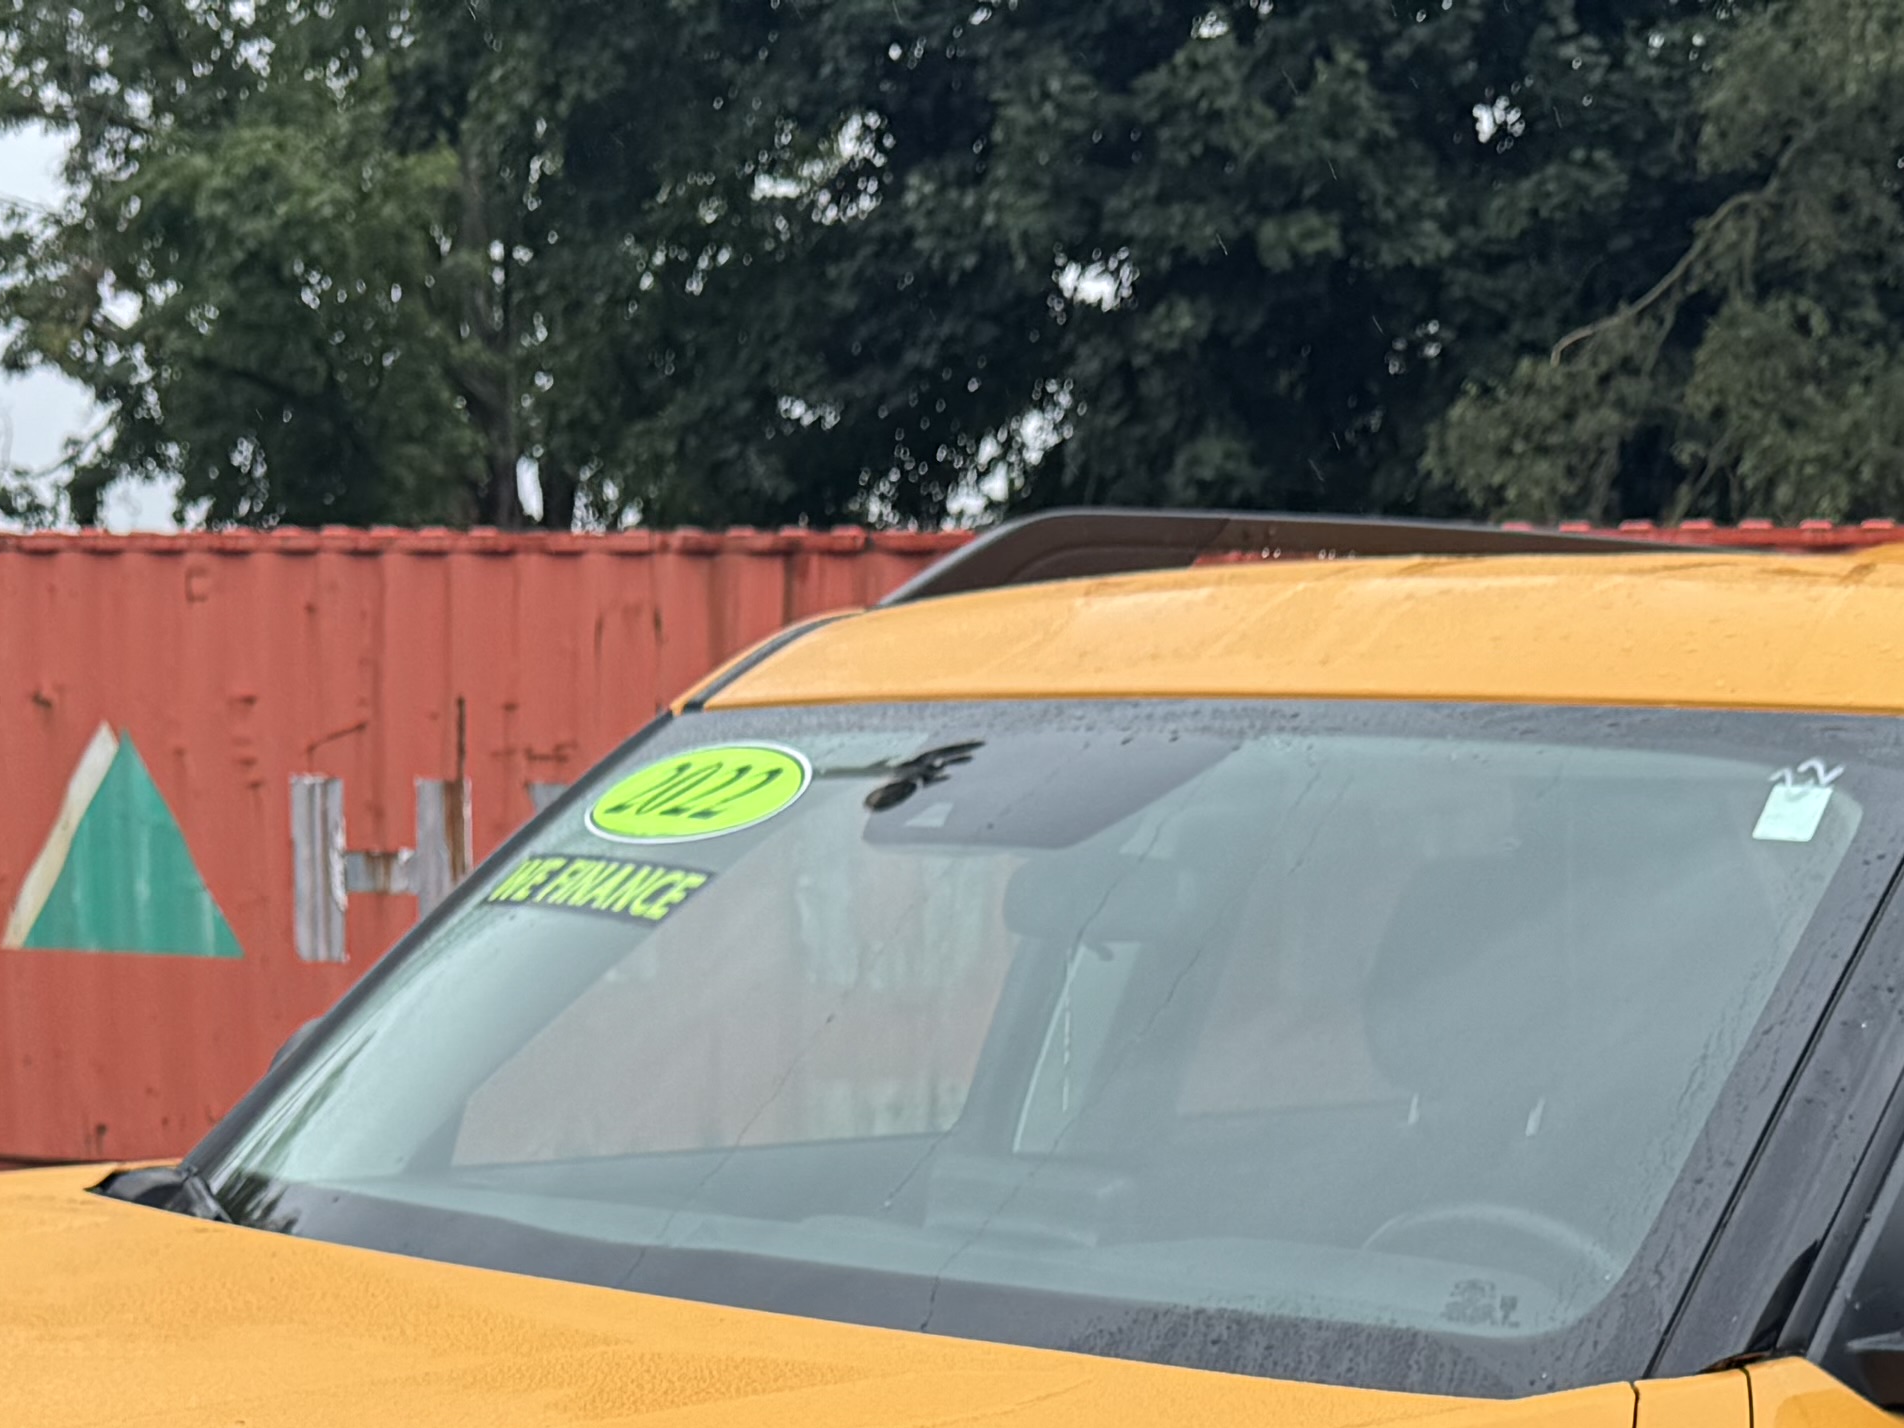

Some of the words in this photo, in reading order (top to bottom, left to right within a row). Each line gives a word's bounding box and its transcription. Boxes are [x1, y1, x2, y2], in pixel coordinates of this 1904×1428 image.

[603, 761, 784, 820] 2022
[488, 856, 567, 902] WE
[536, 857, 709, 922] FINANCE
